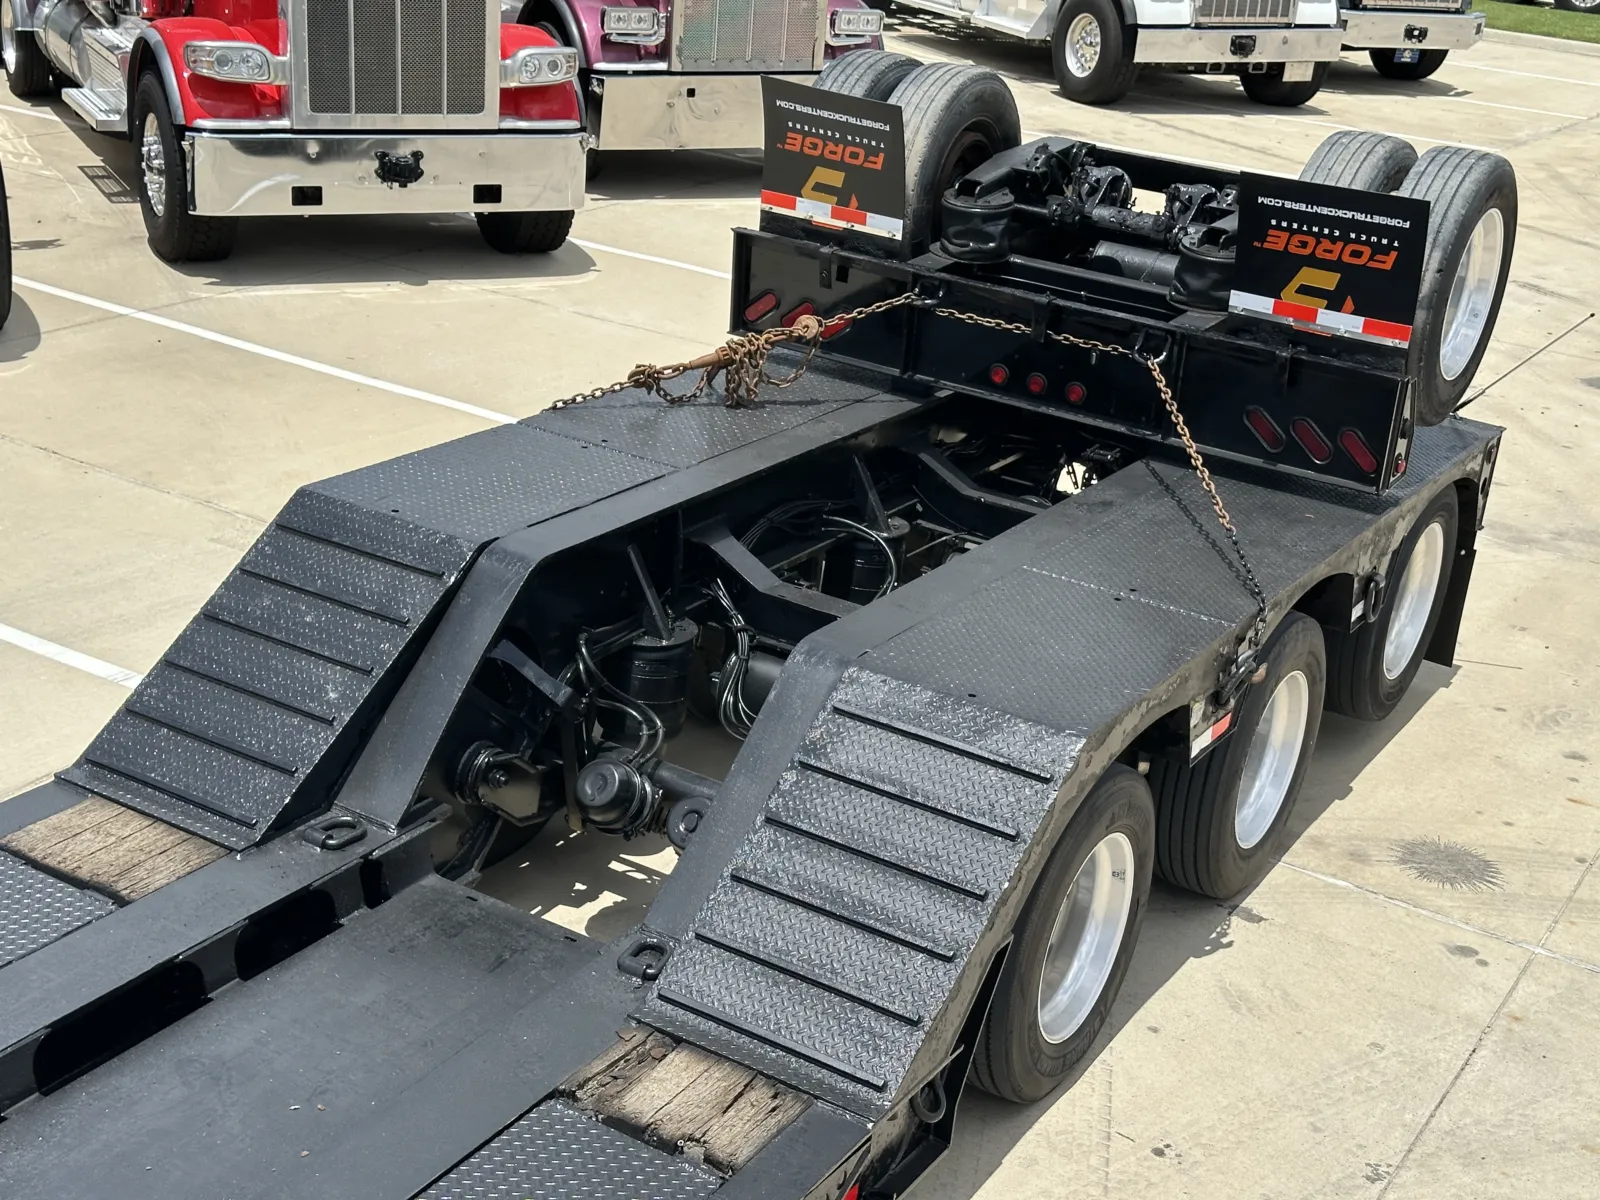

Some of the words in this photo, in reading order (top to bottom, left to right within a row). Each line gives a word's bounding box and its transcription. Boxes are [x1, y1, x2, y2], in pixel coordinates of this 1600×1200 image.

[776, 99, 890, 131] FORGETRUCKCENTERS.COM
[787, 121, 840, 138] CENTERS
[847, 135, 885, 148] TRUCK
[1257, 196, 1410, 228] FORGETRUCKCENTERS.COM
[1270, 219, 1340, 236] CENTERS
[1349, 232, 1399, 246] TRUCK
